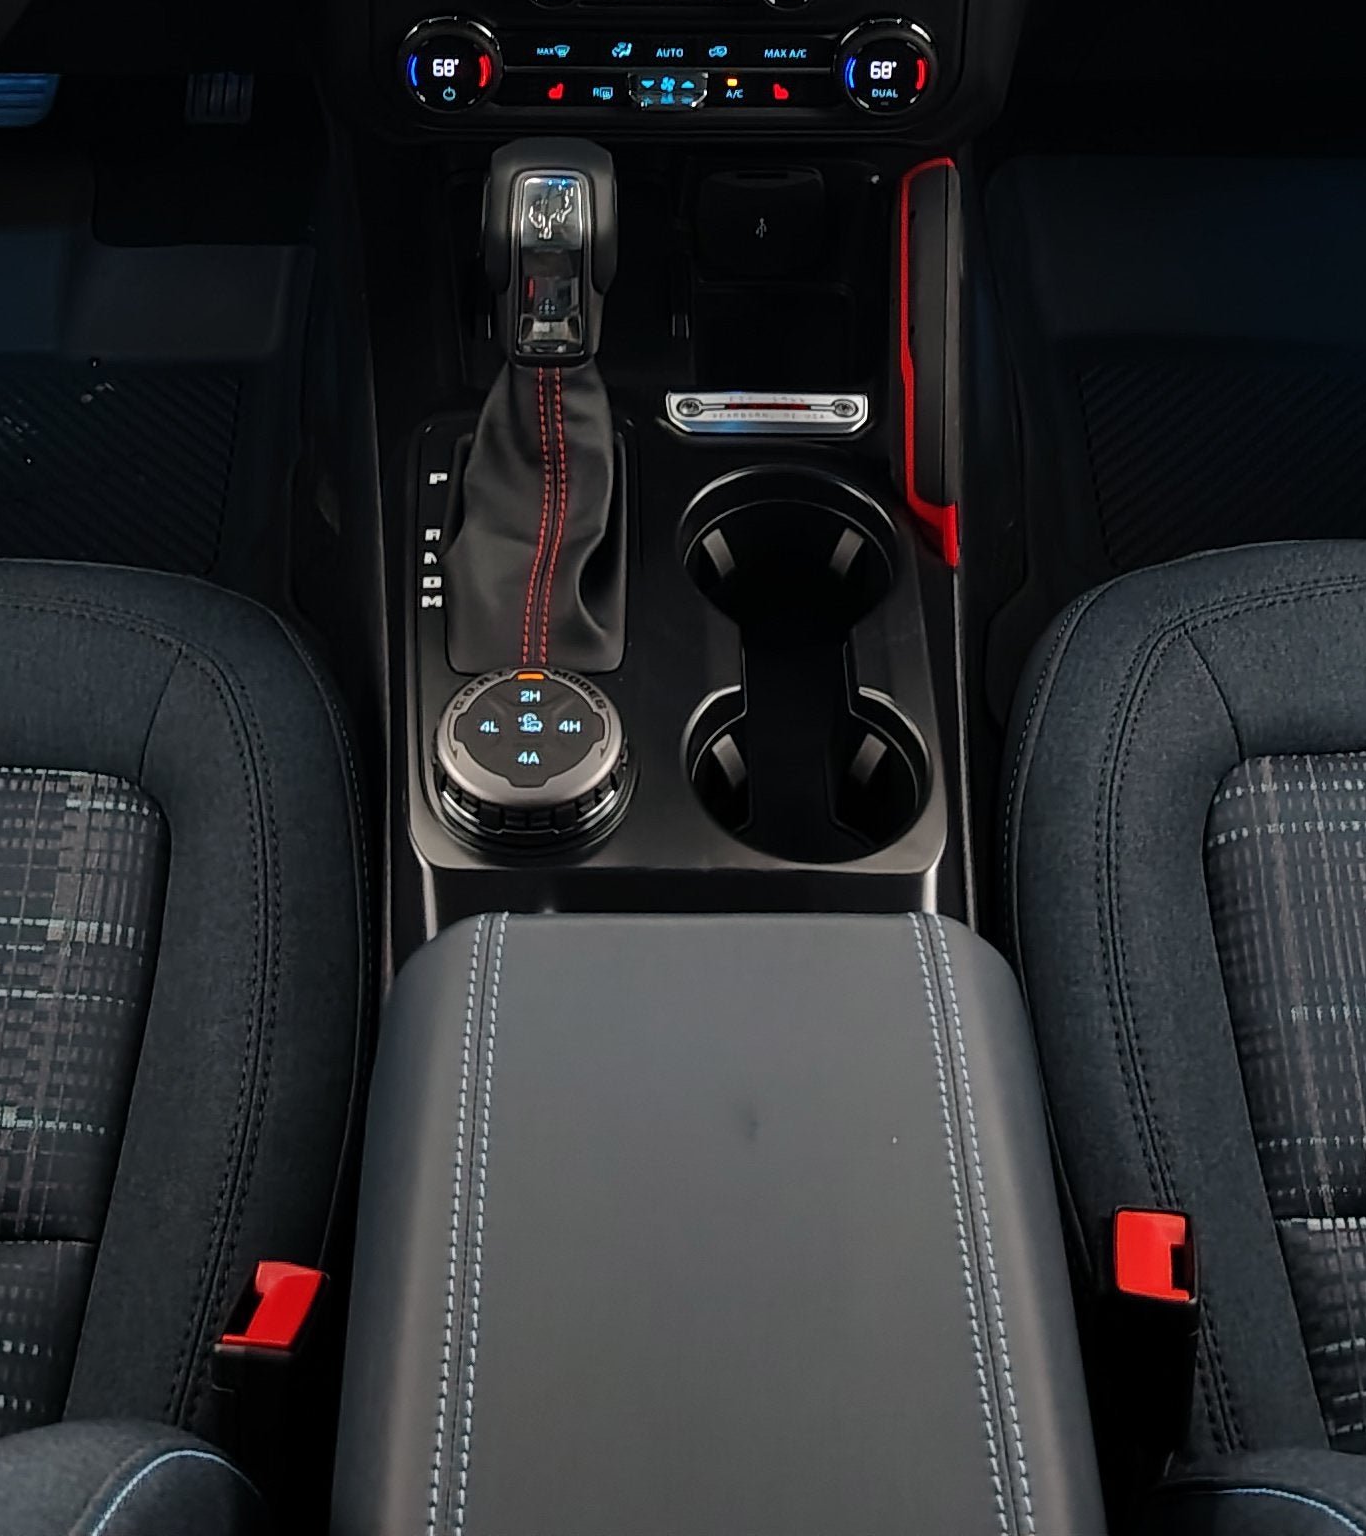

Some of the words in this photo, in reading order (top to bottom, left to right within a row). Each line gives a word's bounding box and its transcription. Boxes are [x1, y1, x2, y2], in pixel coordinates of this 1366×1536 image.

[536, 47, 554, 56] MAX
[655, 47, 684, 58] AUTO
[764, 48, 786, 58] MAX
[789, 48, 807, 59] A/C
[725, 88, 744, 98] A/C
[871, 88, 898, 98] DUAL
[428, 472, 448, 484] P
[421, 595, 443, 608] M
[552, 668, 608, 710] MODES
[520, 689, 541, 703] 2H
[479, 720, 500, 733] 4L
[558, 720, 581, 733] 4H
[517, 751, 540, 765] 4A
